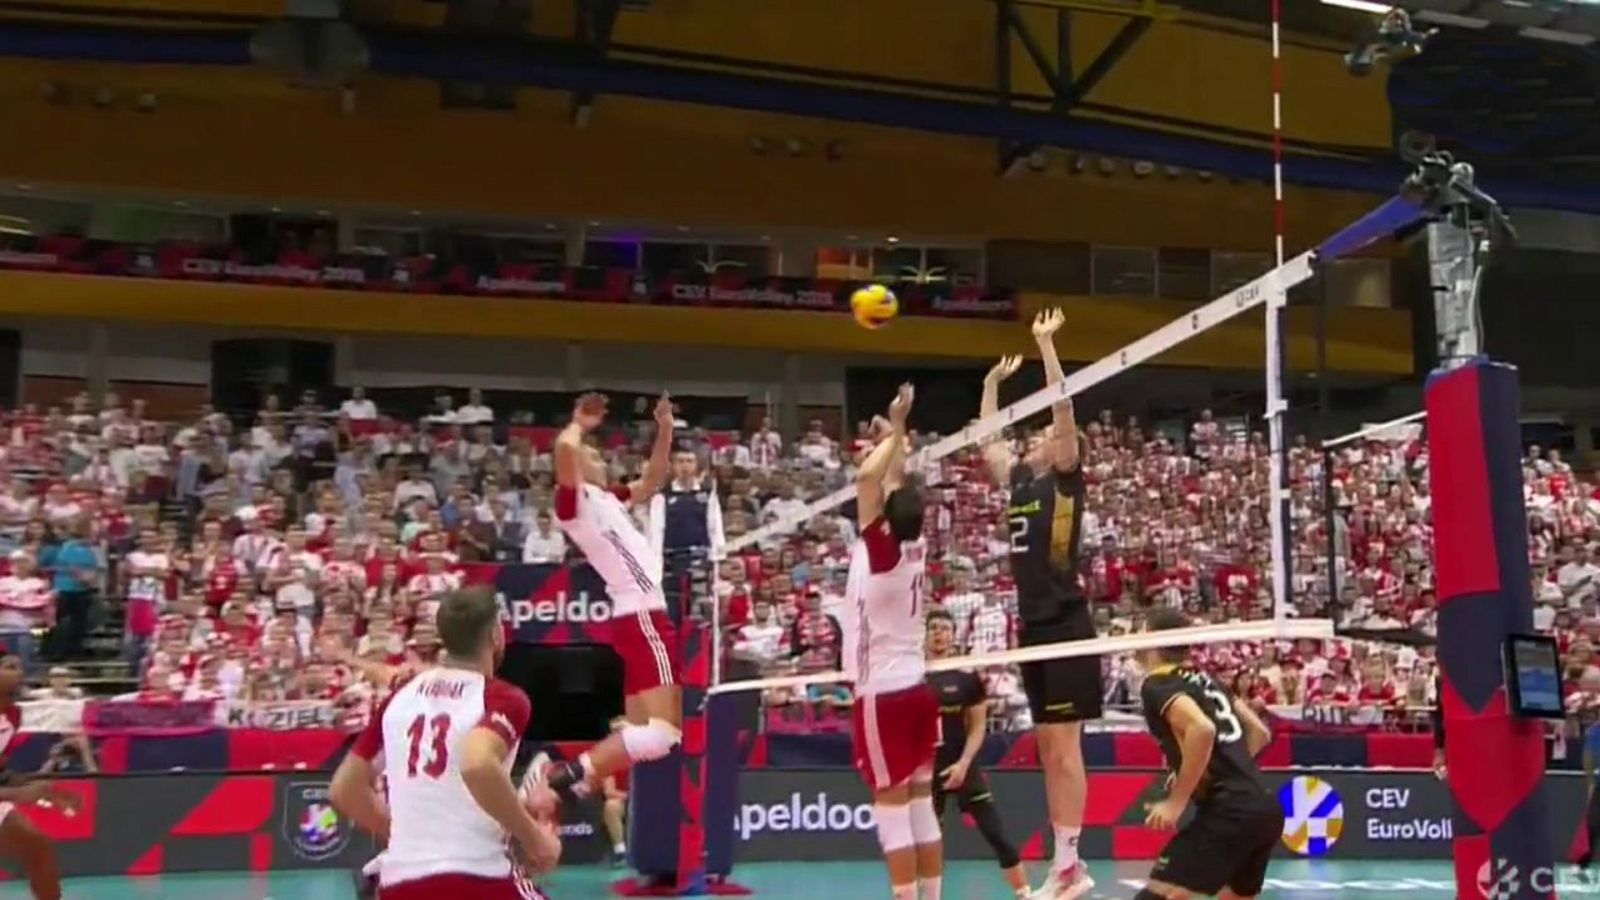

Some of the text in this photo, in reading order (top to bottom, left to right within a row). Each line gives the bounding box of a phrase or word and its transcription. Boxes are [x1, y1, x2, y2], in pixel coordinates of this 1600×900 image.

[1203, 689, 1242, 743] 3
[407, 712, 451, 779] 13
[733, 792, 877, 840] peldoo
[1366, 788, 1410, 809] CEV
[1367, 818, 1453, 840] EuroVoll
